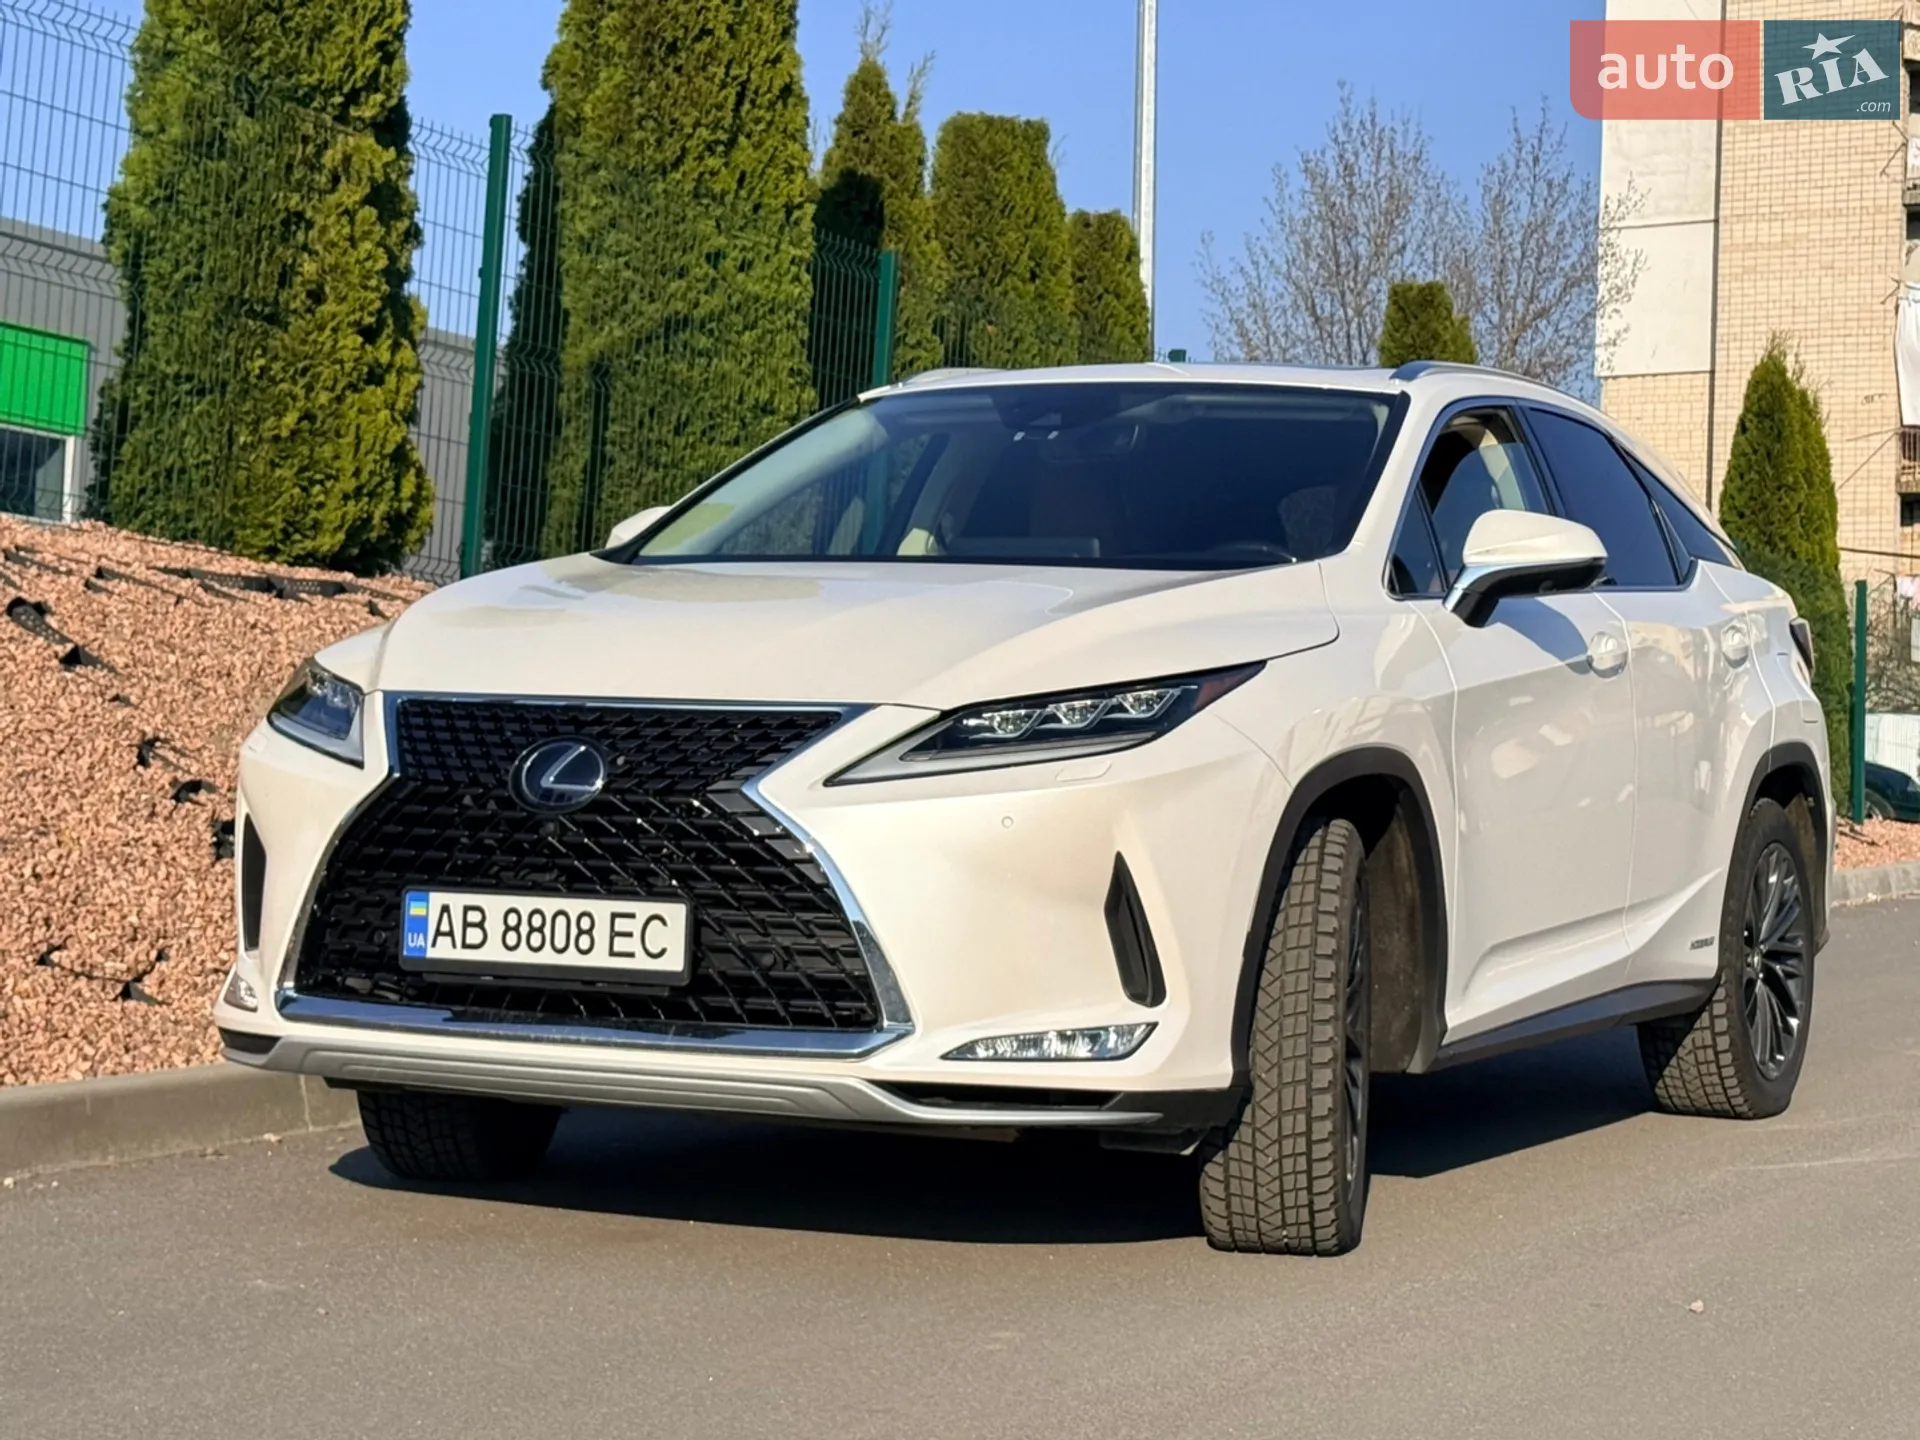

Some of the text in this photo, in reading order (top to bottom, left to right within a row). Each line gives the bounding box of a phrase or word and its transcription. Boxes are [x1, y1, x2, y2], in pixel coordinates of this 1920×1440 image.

[408, 934, 425, 948] UA
[431, 903, 669, 960] AB 8808 EC
